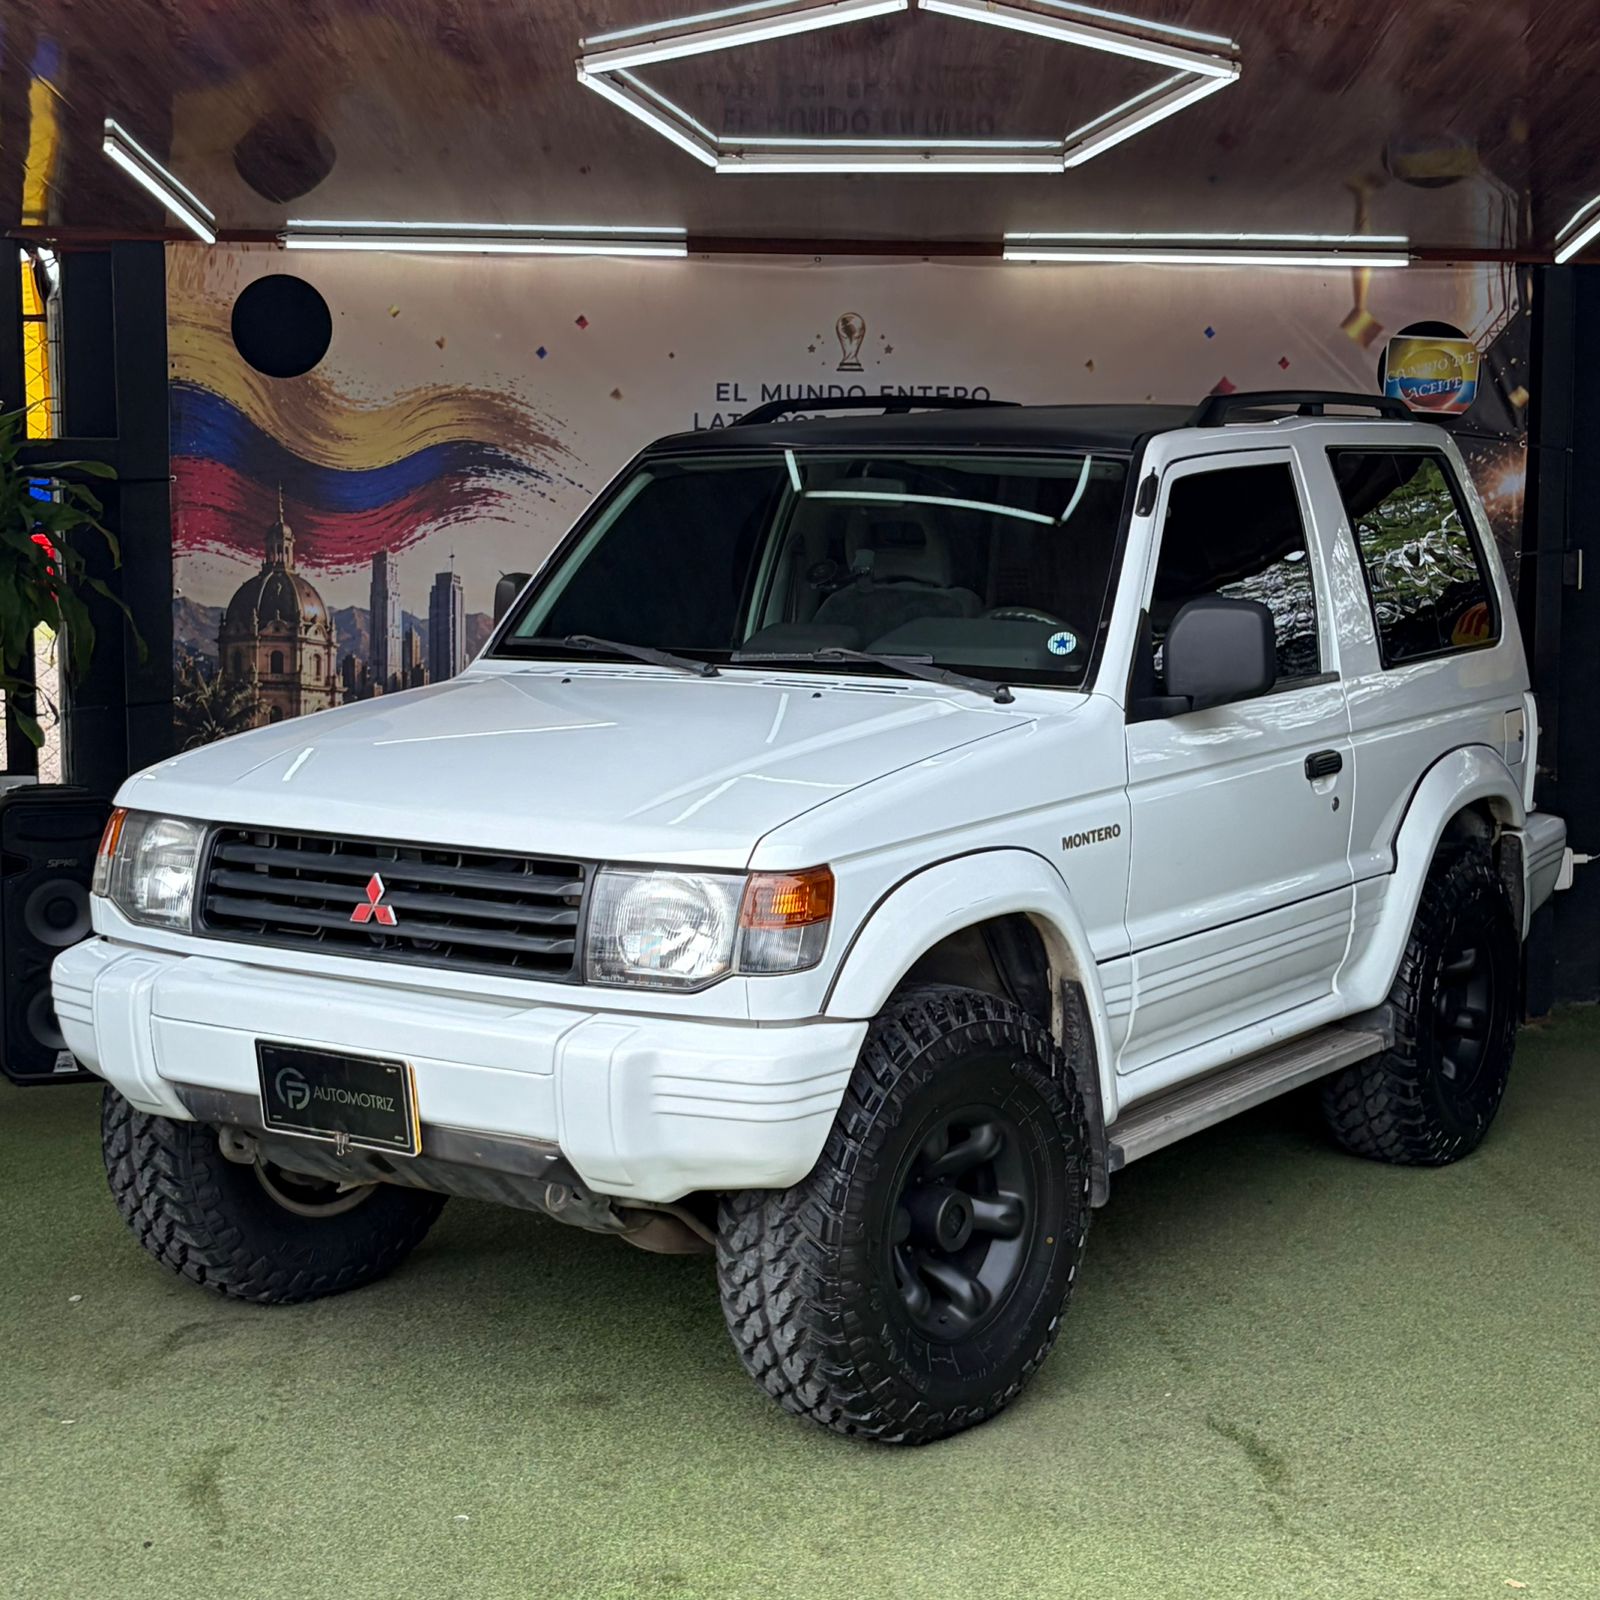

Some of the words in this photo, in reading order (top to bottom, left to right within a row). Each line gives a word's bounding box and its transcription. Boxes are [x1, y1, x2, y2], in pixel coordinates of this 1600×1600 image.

[1452, 351, 1475, 368] DE
[716, 383, 747, 402] EL
[761, 384, 866, 402] MUNDO
[880, 385, 990, 400] ENTERO
[1406, 376, 1462, 400] ACEITE
[694, 412, 743, 432] LAT
[1061, 823, 1121, 851] MONTERO
[313, 1085, 395, 1112] AUTOMOTRIZ
